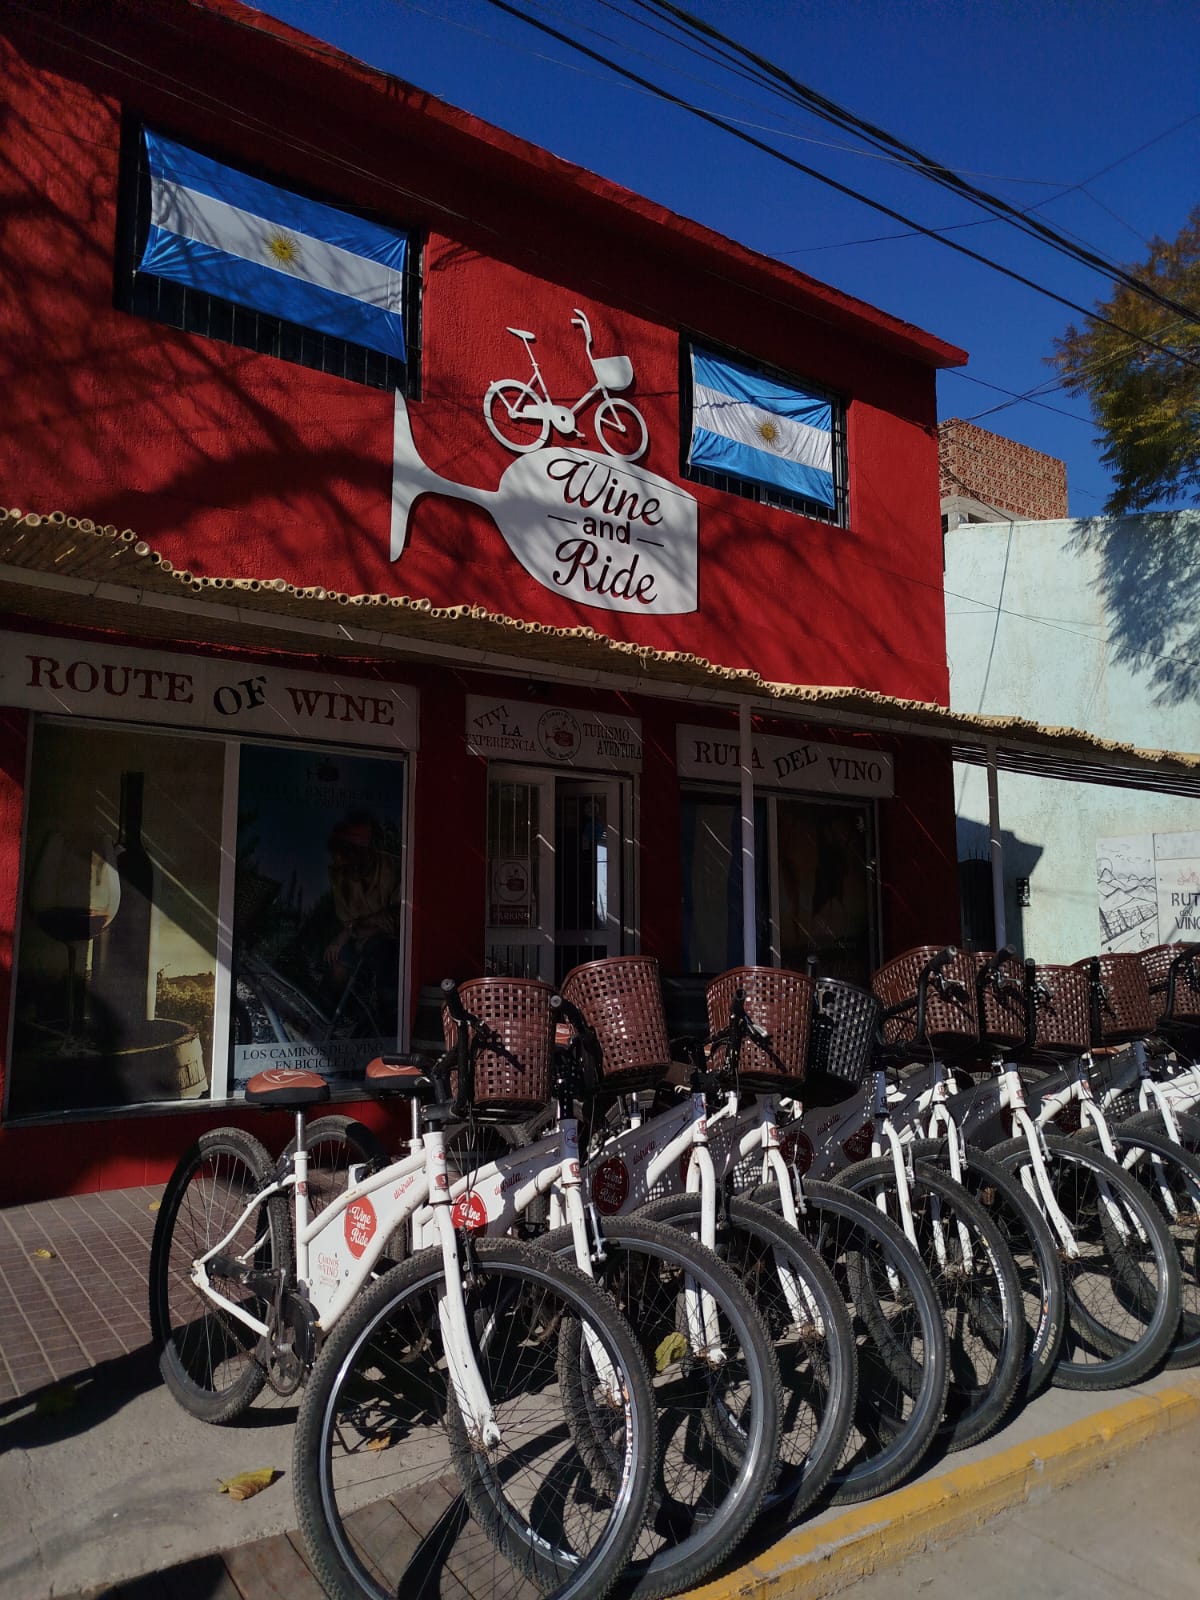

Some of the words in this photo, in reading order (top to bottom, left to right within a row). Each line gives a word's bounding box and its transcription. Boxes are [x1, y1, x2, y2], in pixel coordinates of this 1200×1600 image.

[546, 458, 664, 526] Wine
[583, 517, 631, 544] and
[552, 538, 658, 604] Ride
[26, 655, 194, 704] ROUTE
[213, 676, 267, 716] OF
[285, 687, 395, 727] WINE
[473, 705, 510, 729] VIVI
[501, 724, 523, 737] LA
[583, 723, 630, 741] TURISMO
[465, 734, 536, 752] EXPERIENCIA
[597, 741, 642, 760] AVENTURA
[773, 745, 818, 778] DEL
[827, 757, 882, 783] VINO
[243, 1050, 267, 1060] LOS
[270, 1046, 326, 1058] CAMINOS
[275, 1060, 291, 1069] EN
[351, 1206, 373, 1224] Wine
[350, 1227, 369, 1247] Ride
